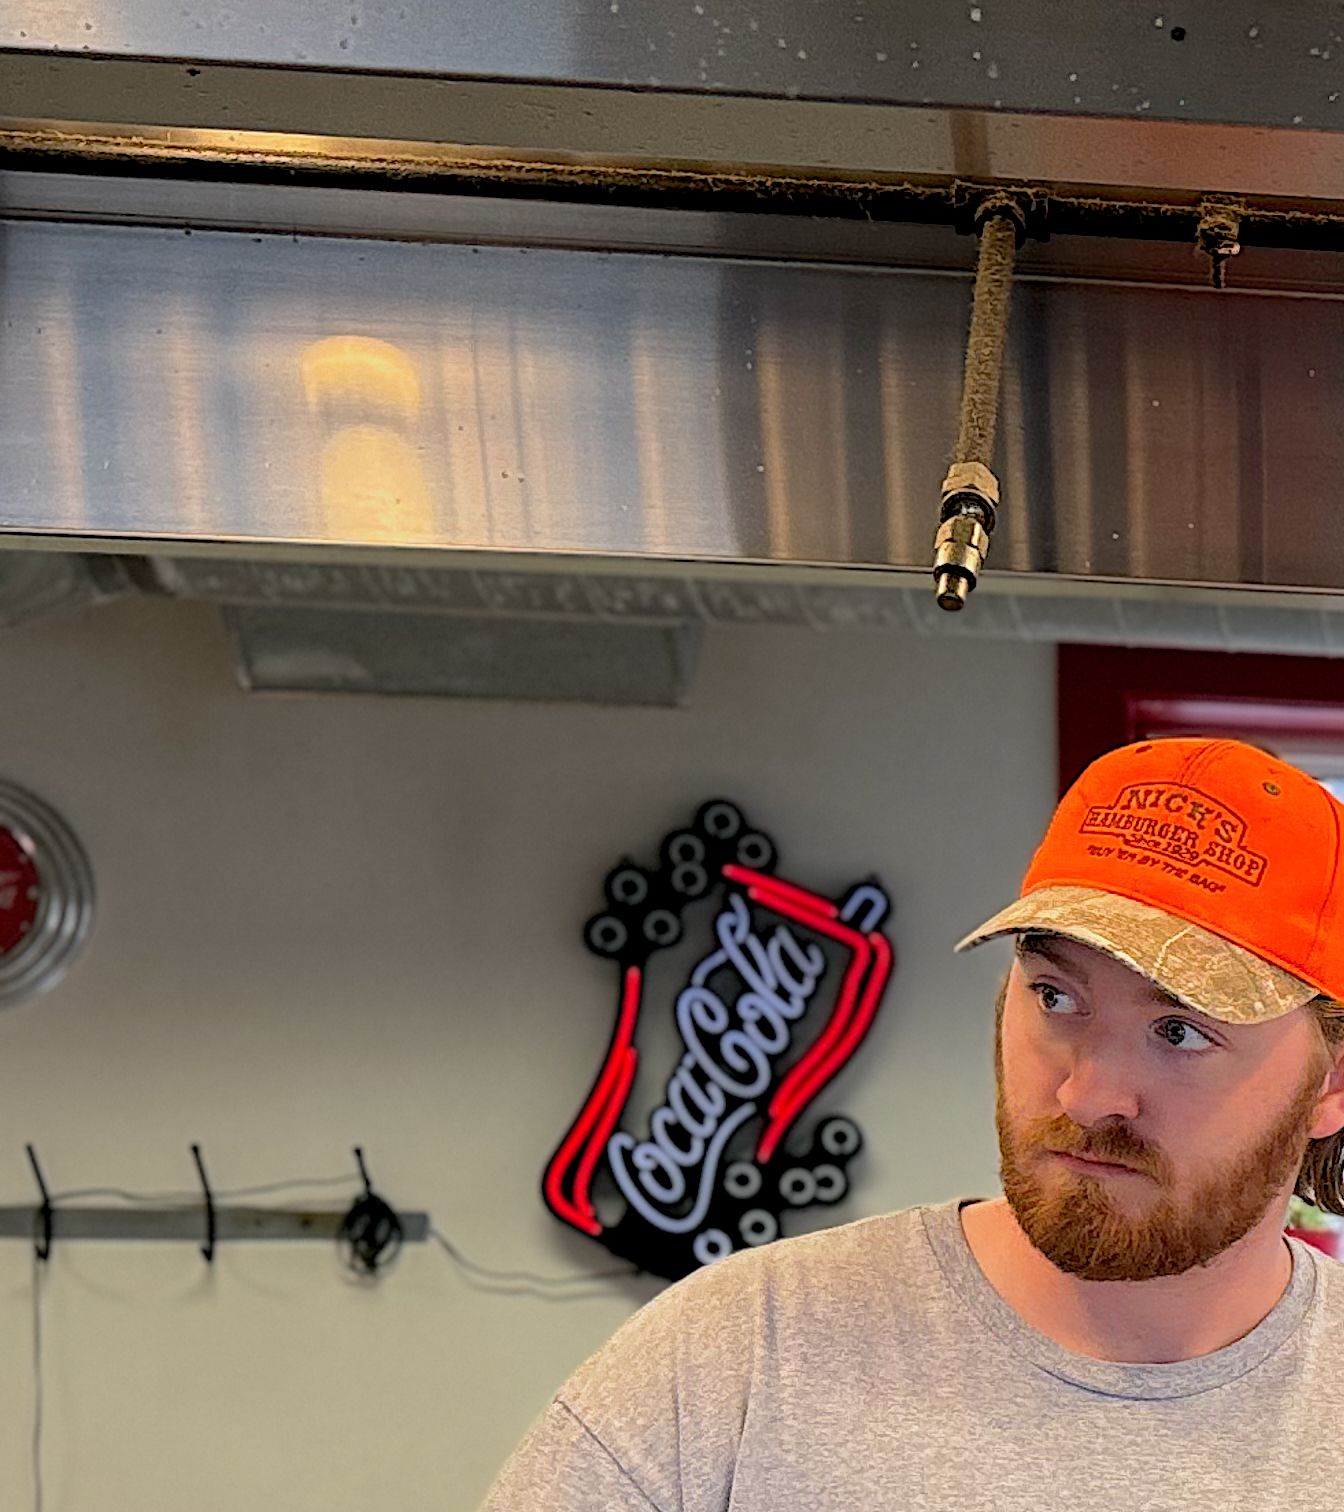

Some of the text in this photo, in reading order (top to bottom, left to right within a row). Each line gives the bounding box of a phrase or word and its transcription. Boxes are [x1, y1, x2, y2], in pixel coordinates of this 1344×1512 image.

[1120, 789, 1239, 843] NICK'S
[1085, 811, 1260, 877] HAMBURGER SHOP
[1163, 841, 1199, 862] 1929
